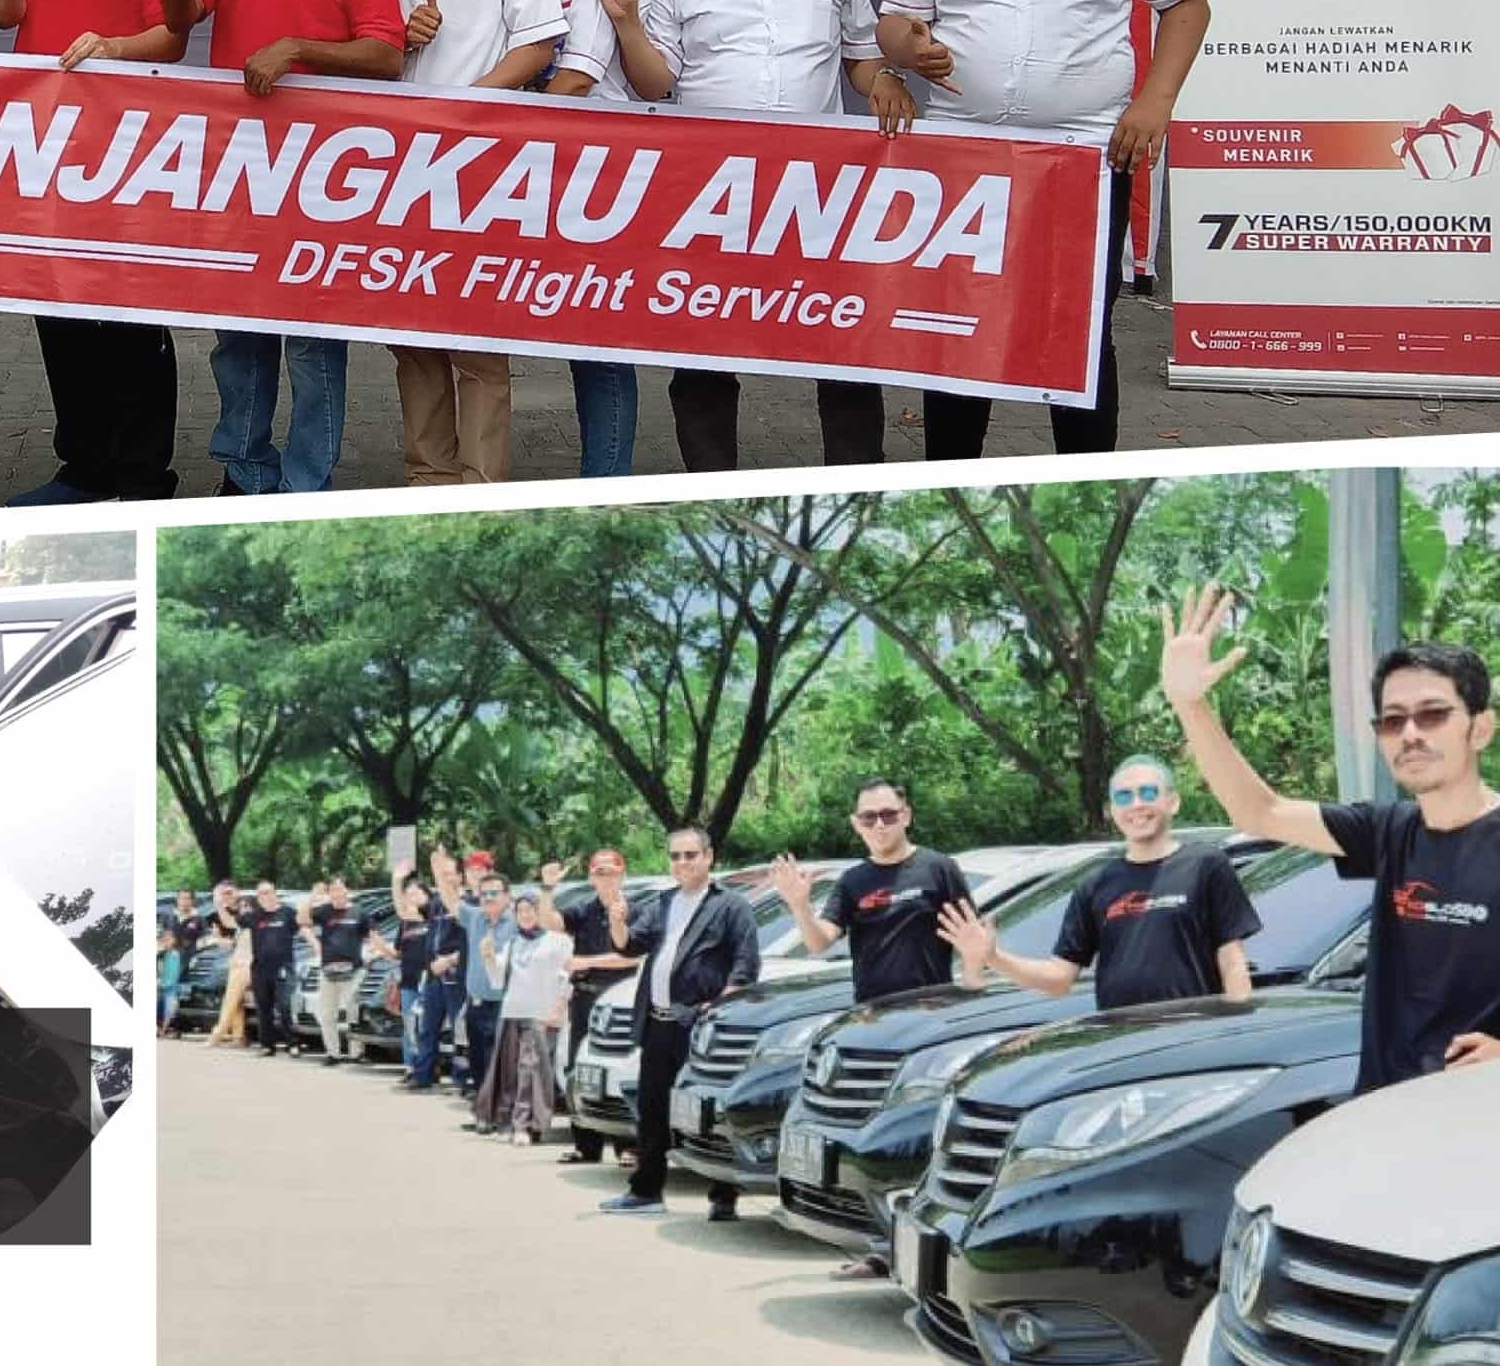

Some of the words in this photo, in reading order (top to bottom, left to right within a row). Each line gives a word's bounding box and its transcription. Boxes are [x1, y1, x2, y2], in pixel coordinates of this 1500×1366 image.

[1279, 26, 1325, 35] JANGAN
[1329, 25, 1394, 35] LEWATKAN
[1204, 43, 1298, 56] BERBAGAI
[1306, 41, 1377, 54] HADIAH
[1386, 40, 1473, 53] MENARIK
[1266, 61, 1350, 74] MENANTI
[1358, 61, 1409, 73] ANDA
[1203, 129, 1302, 143] SOUVENIR
[1223, 149, 1314, 162] MENARIK
[661, 155, 1012, 275] ANDA
[1198, 214, 1240, 250] 7
[1243, 215, 1492, 233] YEARS/150,000KM
[1246, 234, 1331, 250] SUPER
[1339, 235, 1483, 252] WARRANTY
[279, 240, 453, 296] DFSK
[459, 255, 639, 319] Flight
[648, 269, 866, 331] Service
[1248, 330, 1269, 338] CALL
